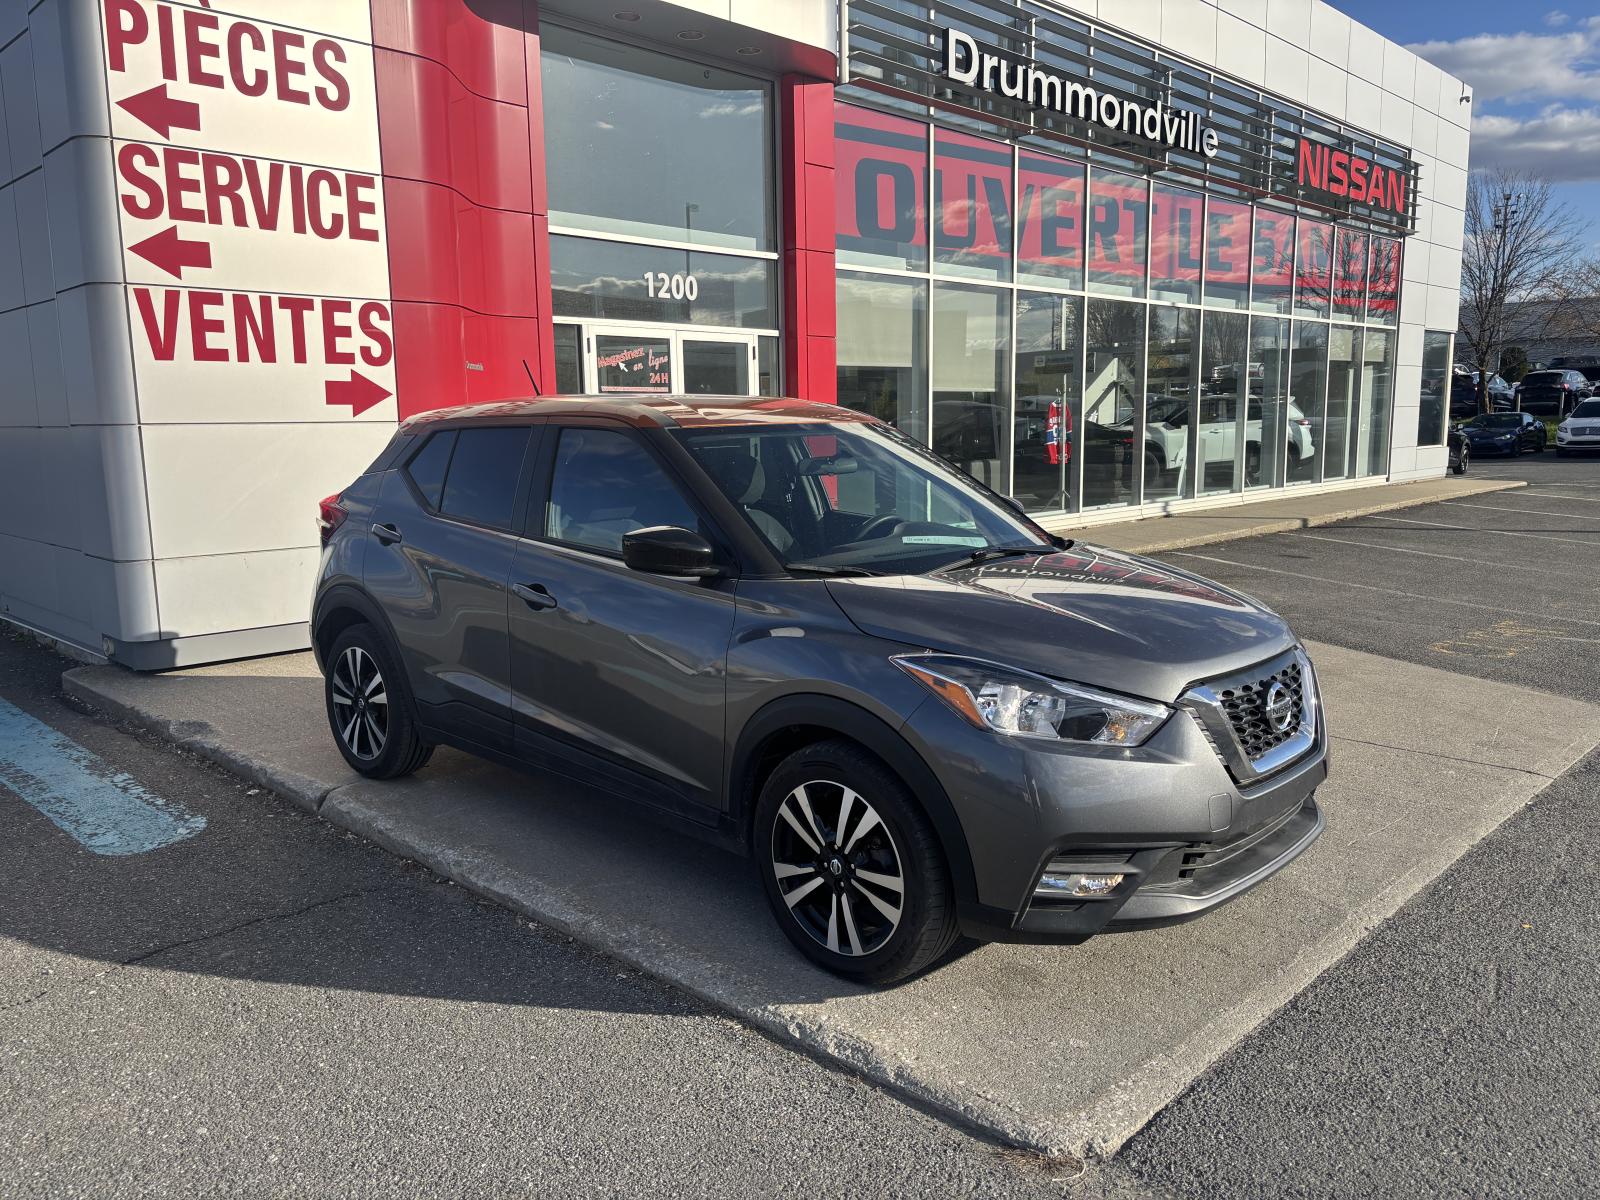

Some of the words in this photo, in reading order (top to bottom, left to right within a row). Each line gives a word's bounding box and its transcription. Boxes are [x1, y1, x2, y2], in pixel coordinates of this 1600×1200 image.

[104, 0, 350, 112] PIÈCES
[945, 27, 1219, 158] Drummondville
[117, 143, 380, 243] SERVICE
[854, 157, 1158, 266] OUVERT
[1178, 207, 1234, 272] LE
[1297, 139, 1406, 215] NISSAN
[134, 287, 393, 368] VENTES
[644, 271, 698, 301] 1200
[648, 348, 669, 371] ligne
